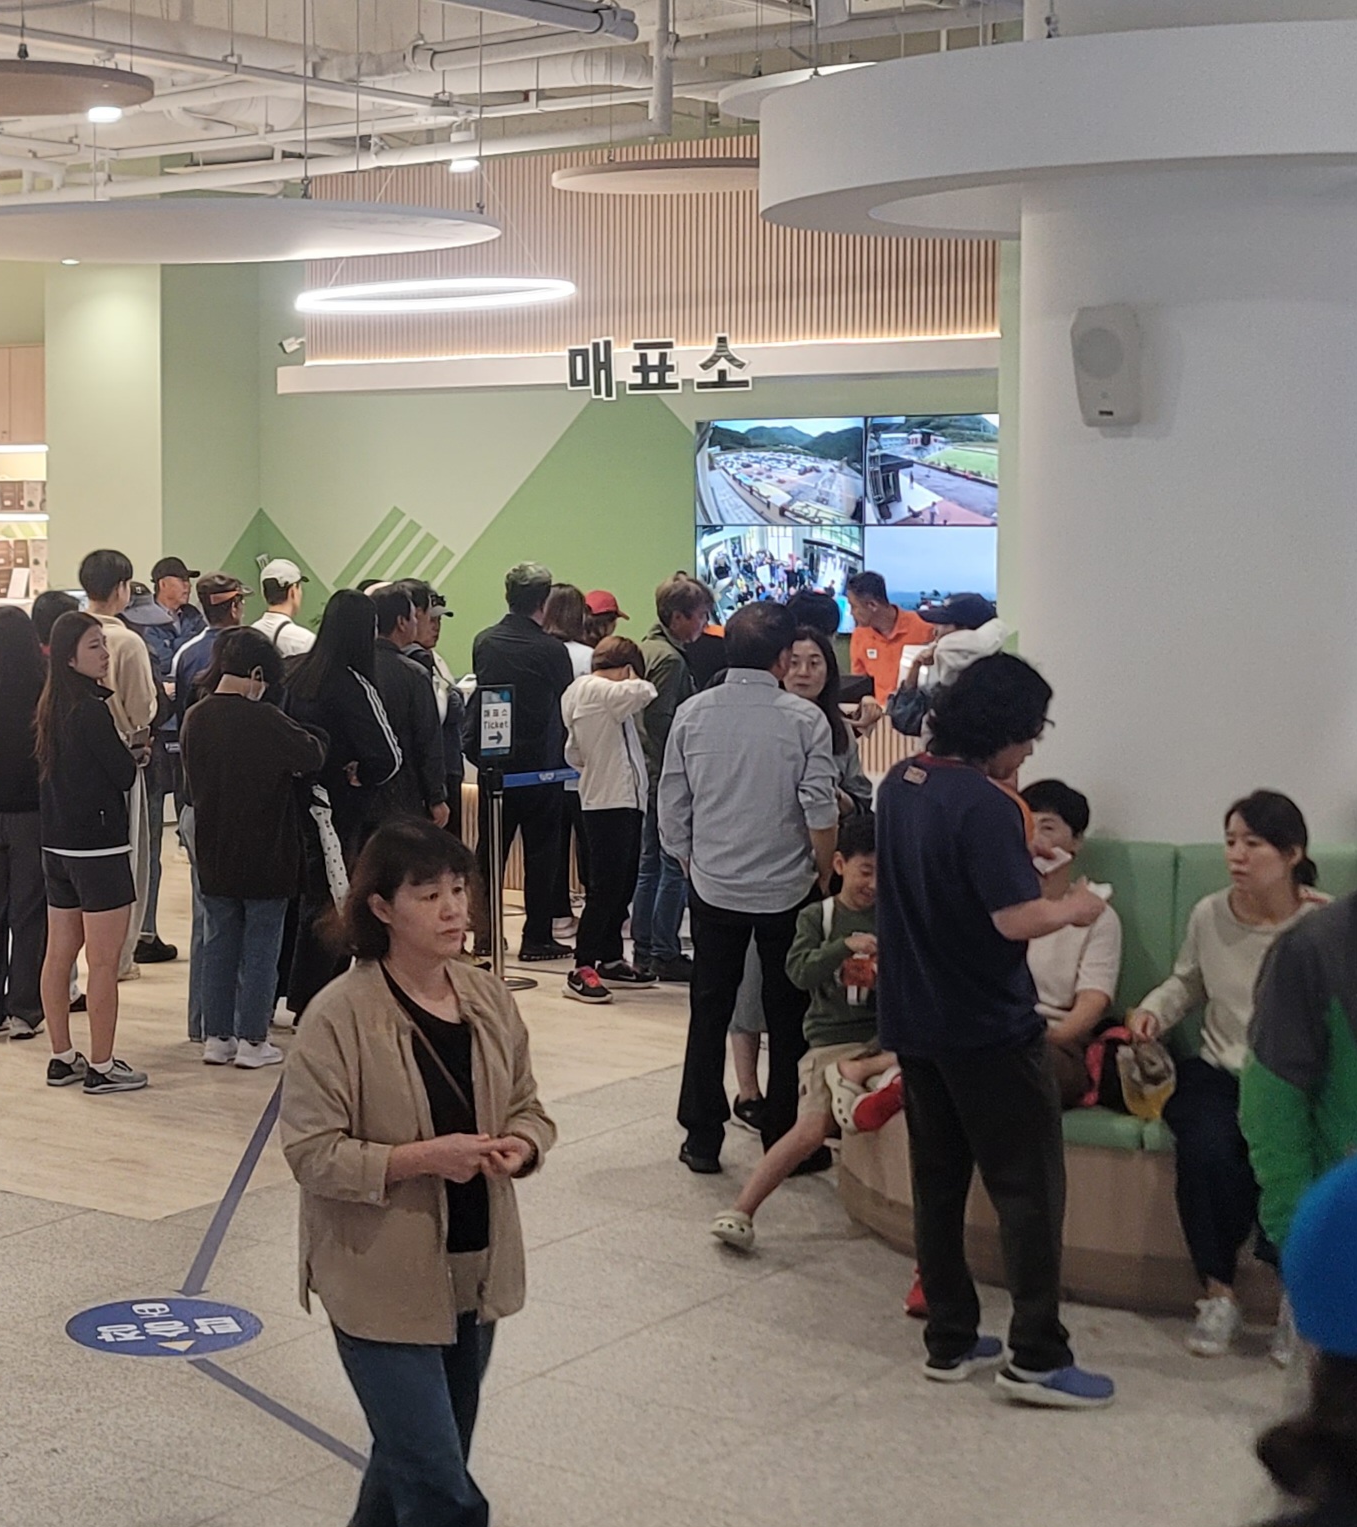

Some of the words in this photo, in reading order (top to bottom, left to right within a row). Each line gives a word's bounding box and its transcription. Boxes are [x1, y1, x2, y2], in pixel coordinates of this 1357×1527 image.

[567, 334, 751, 399] 매표소
[483, 709, 508, 718] 매표소
[483, 720, 508, 730] Ticket
[96, 1315, 243, 1343] 탑승장
